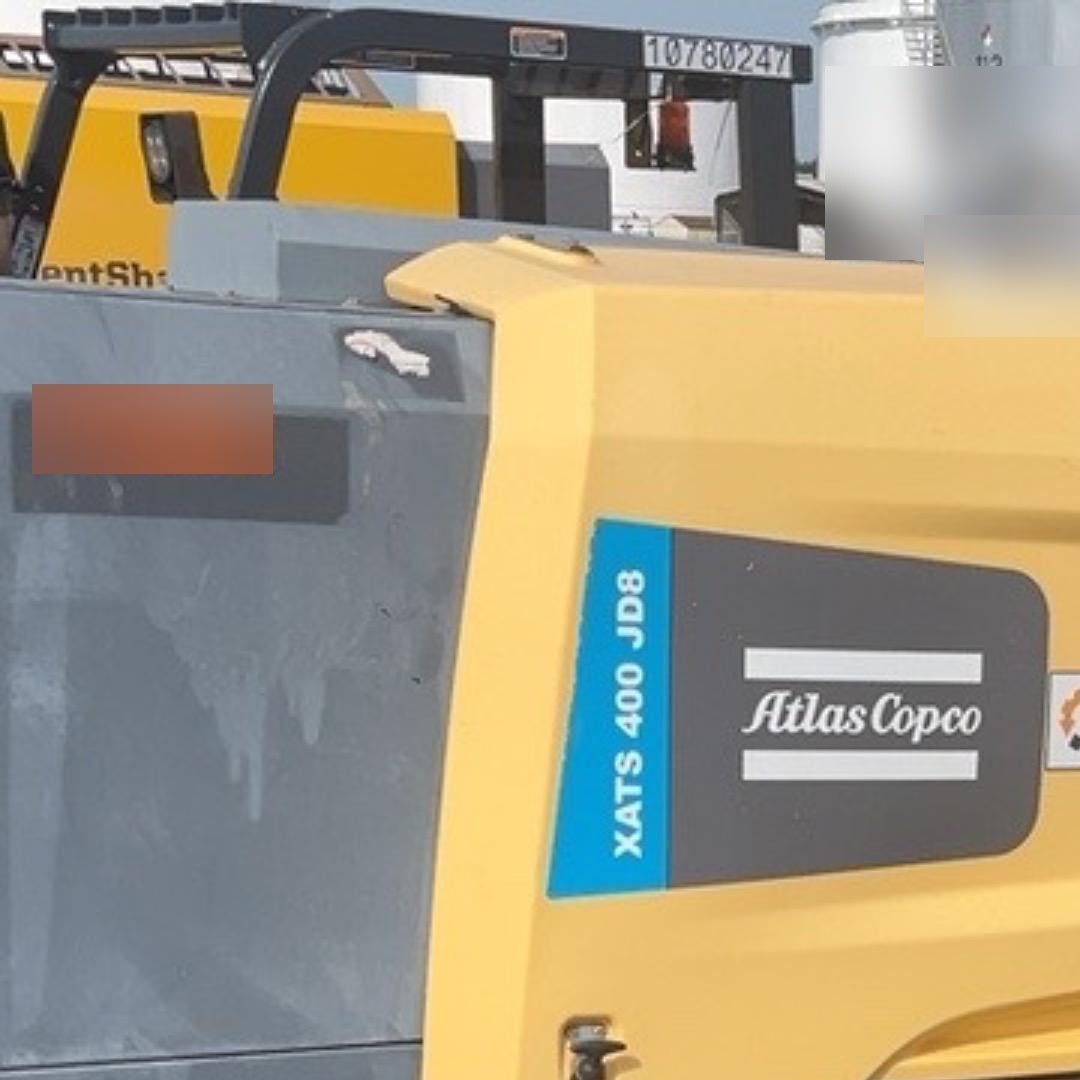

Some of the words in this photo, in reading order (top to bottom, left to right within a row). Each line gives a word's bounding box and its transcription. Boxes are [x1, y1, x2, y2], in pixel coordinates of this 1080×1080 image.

[646, 36, 789, 77] 10780247
[615, 568, 647, 651] JD8
[613, 661, 645, 739] 400
[741, 689, 868, 736] Atlas
[870, 692, 983, 744] Copco
[613, 750, 644, 860] XATS
